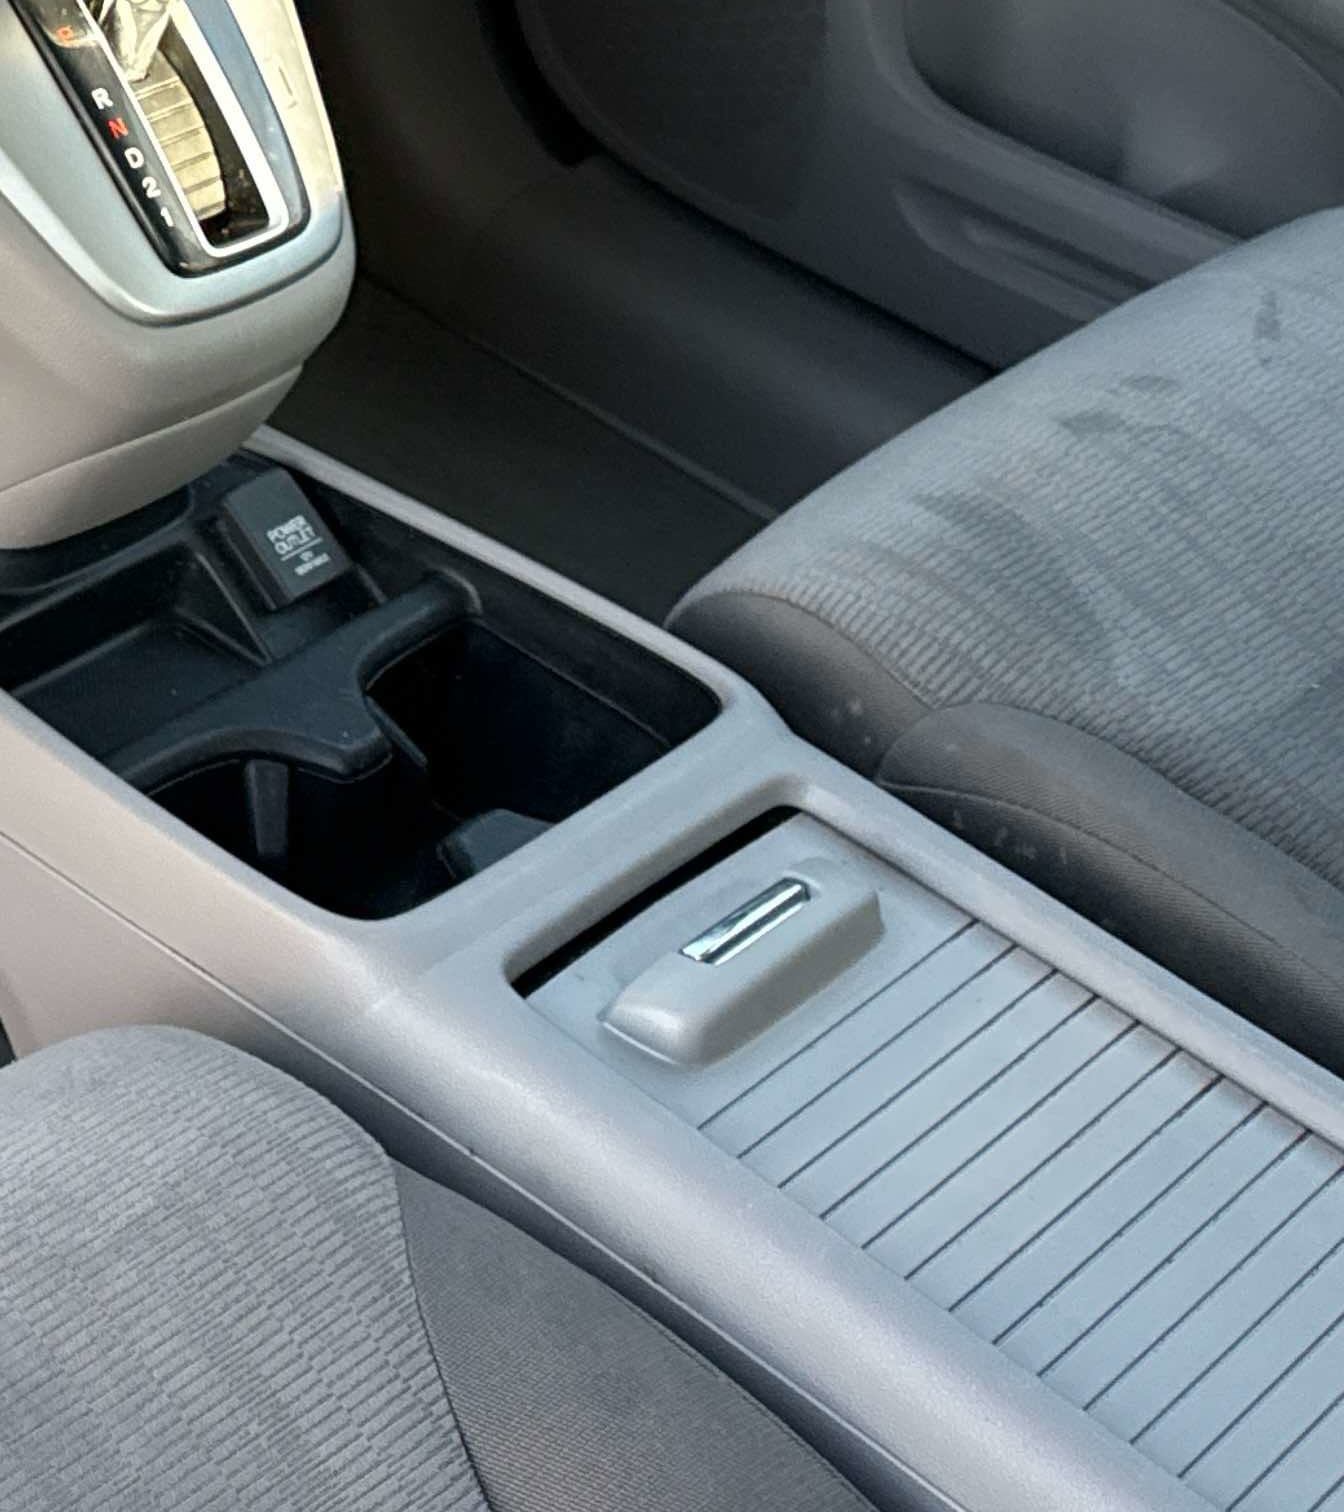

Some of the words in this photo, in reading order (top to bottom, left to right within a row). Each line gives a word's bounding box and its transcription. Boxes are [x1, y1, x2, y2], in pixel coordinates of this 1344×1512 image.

[91, 87, 114, 110] R
[107, 117, 129, 139] N
[124, 147, 145, 169] D
[142, 177, 162, 199] 2
[160, 206, 174, 227] 1
